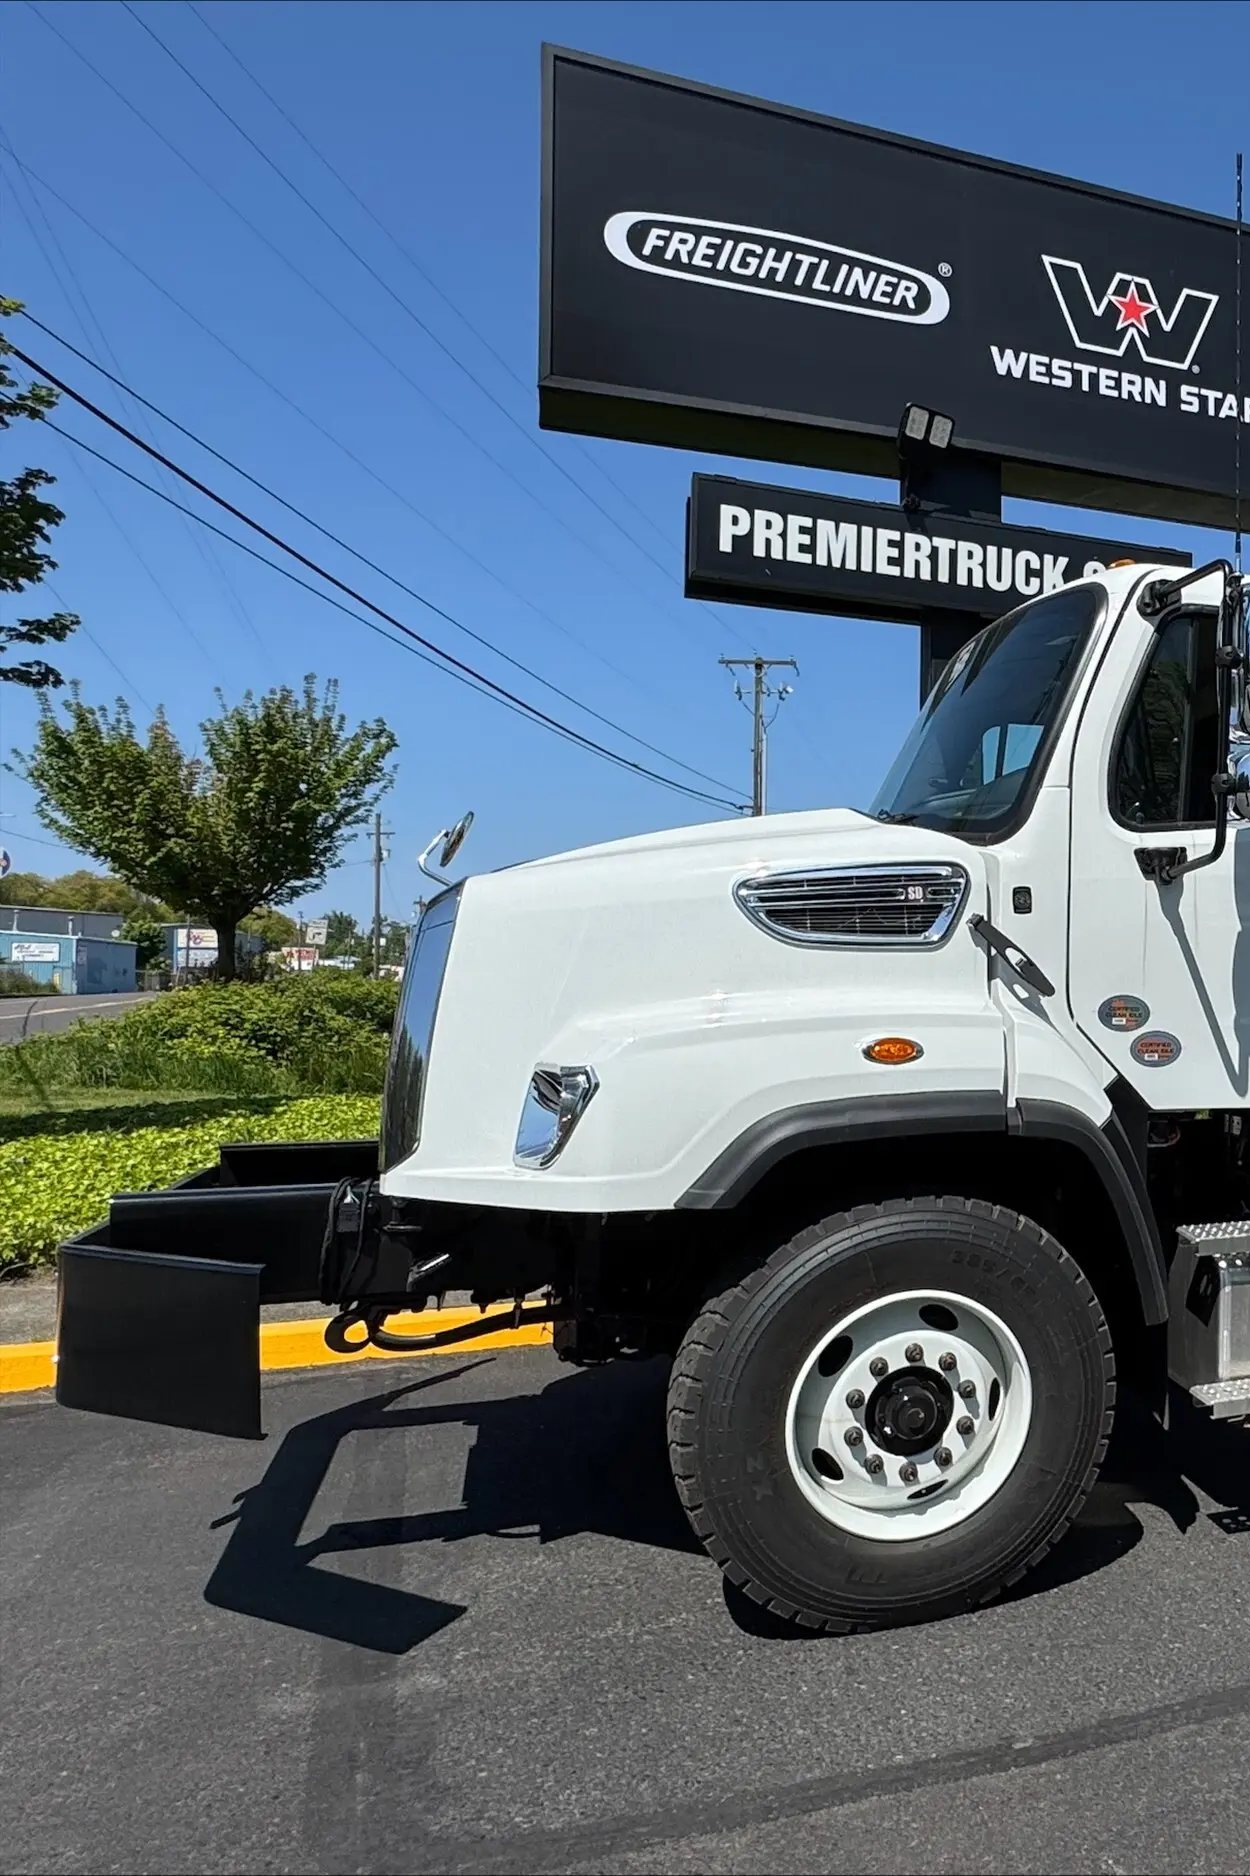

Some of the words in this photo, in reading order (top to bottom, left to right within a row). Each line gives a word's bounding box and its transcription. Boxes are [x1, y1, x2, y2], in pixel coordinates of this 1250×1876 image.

[641, 227, 919, 311] FREIGHTLINER
[989, 345, 1167, 408] WESTERN
[717, 503, 1106, 596] PREMIERTRUCK
[907, 886, 924, 900] SD
